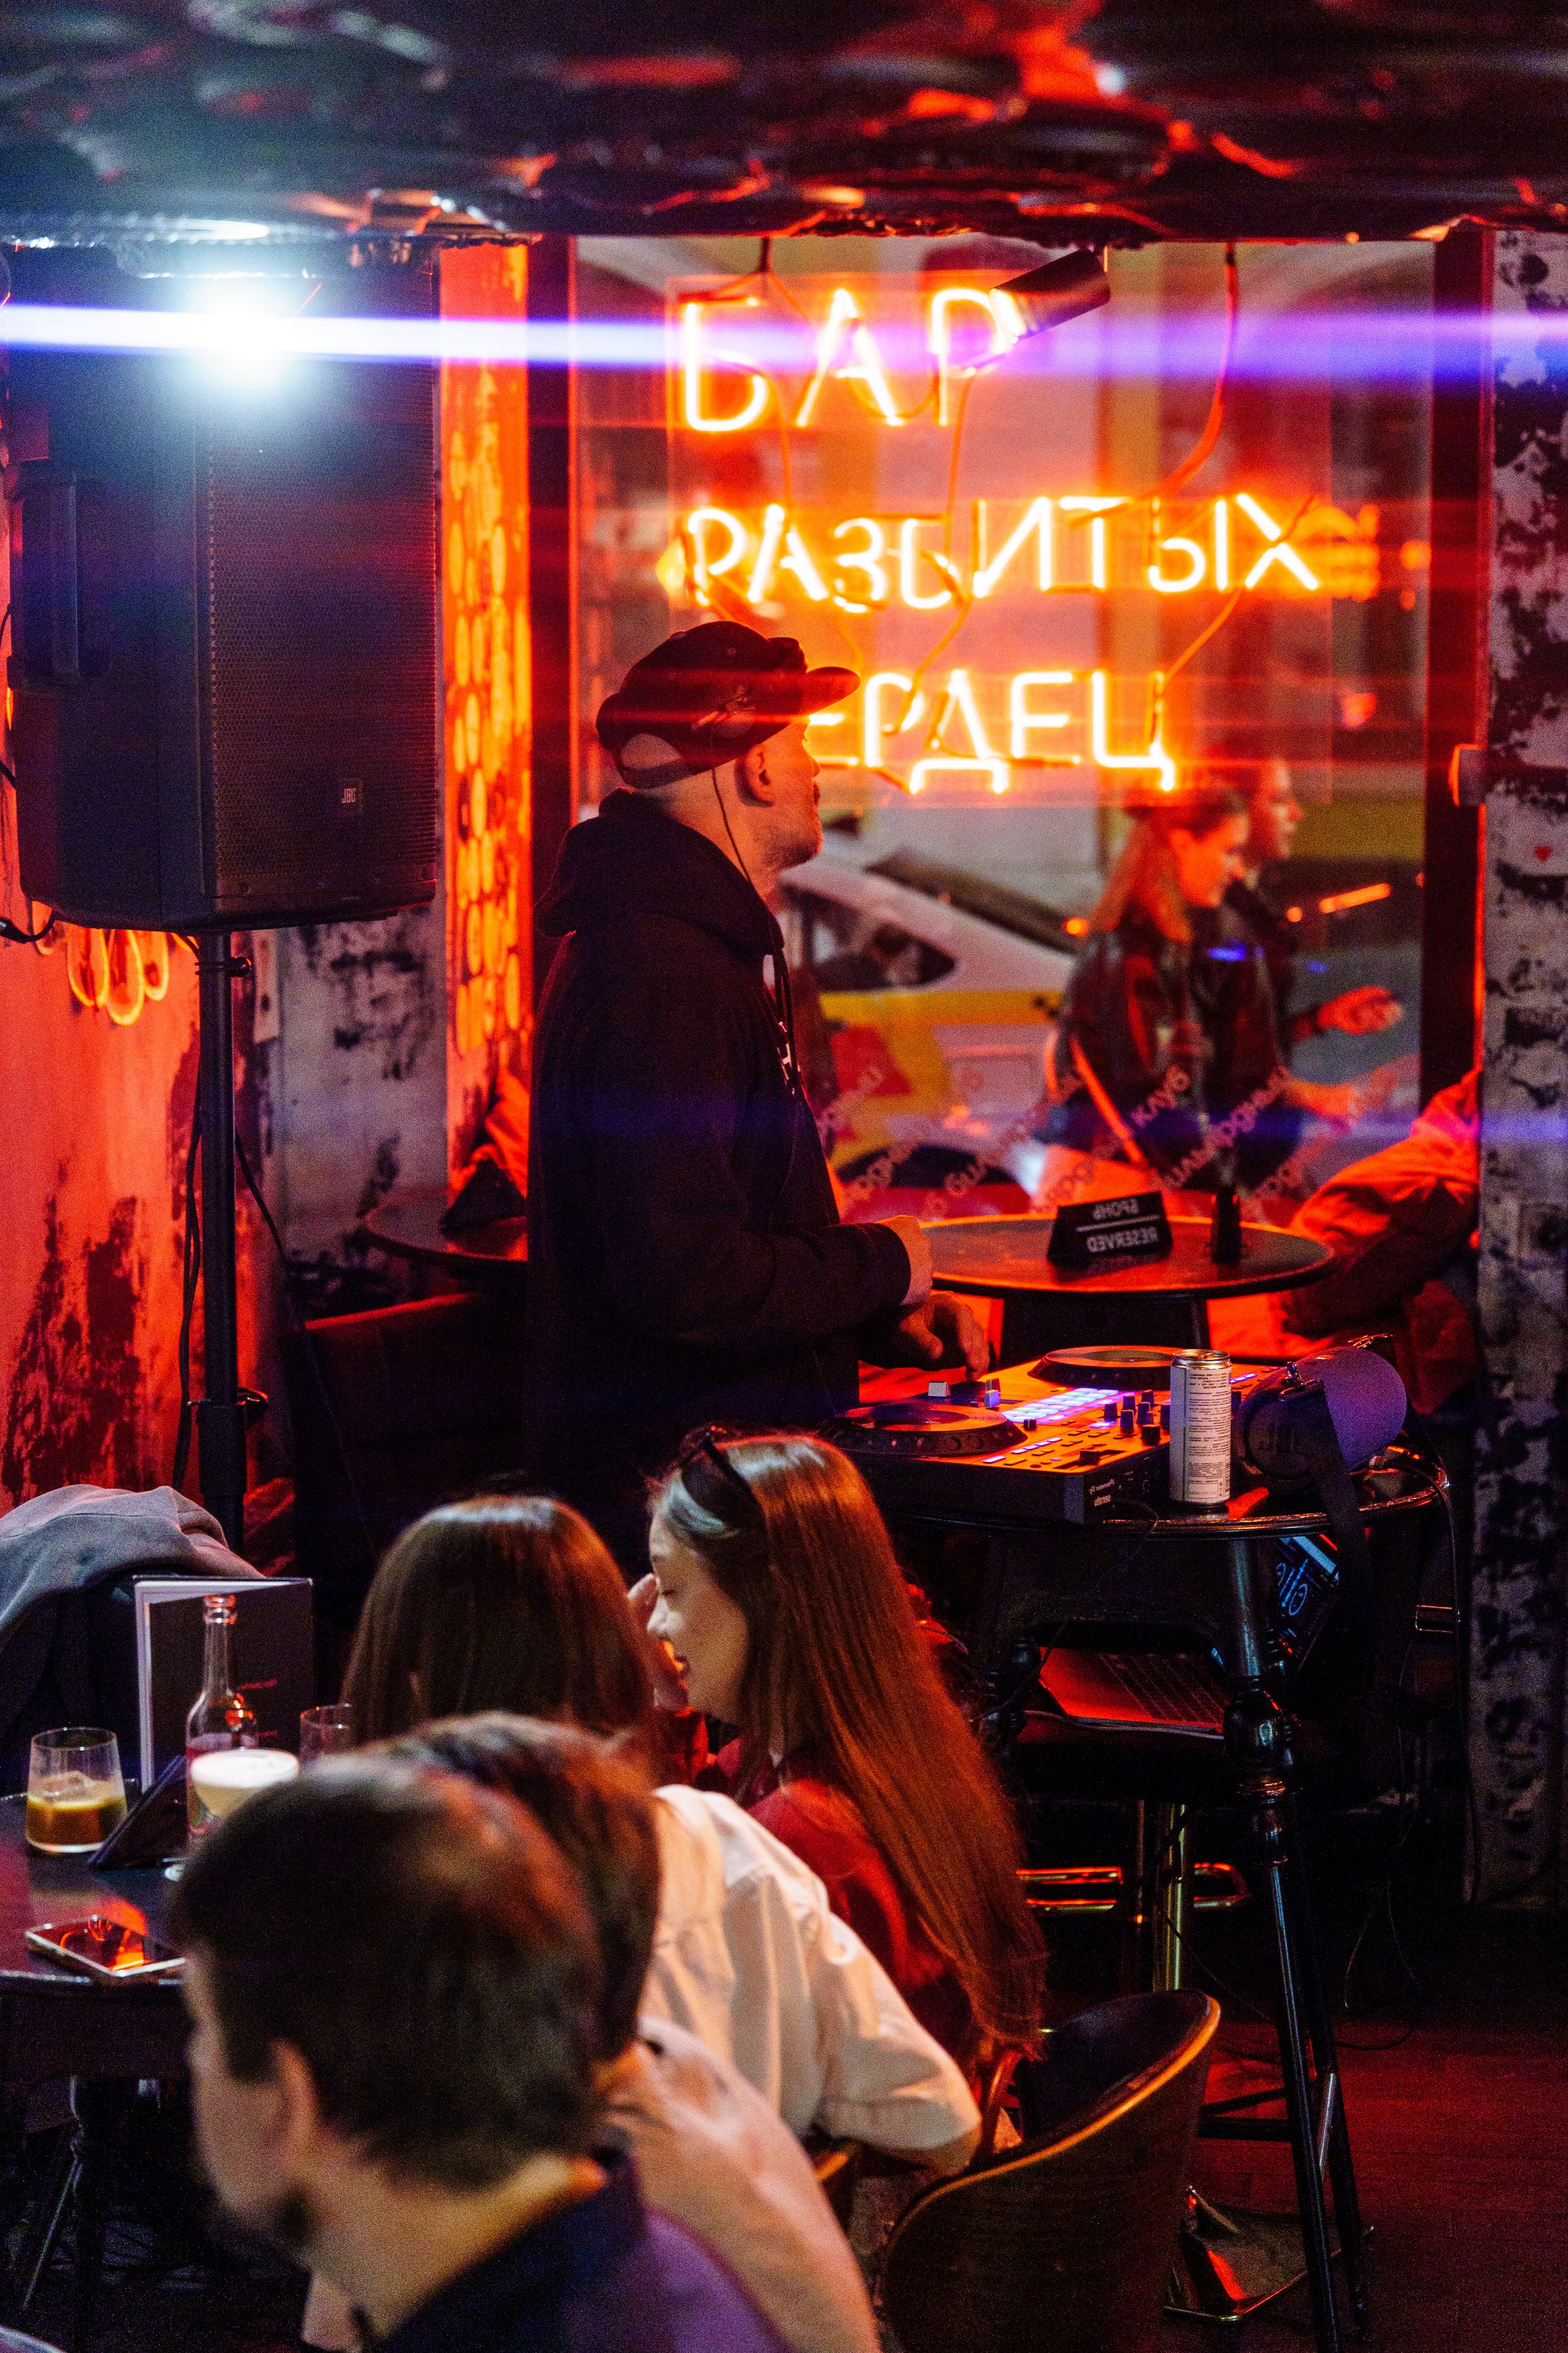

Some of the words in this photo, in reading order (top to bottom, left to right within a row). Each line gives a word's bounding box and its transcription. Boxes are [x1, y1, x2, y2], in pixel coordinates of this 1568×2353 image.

[682, 287, 1014, 432] БАР
[684, 493, 1319, 613] РАЗБИТЫХ
[809, 669, 1176, 794] РДЕЦ
